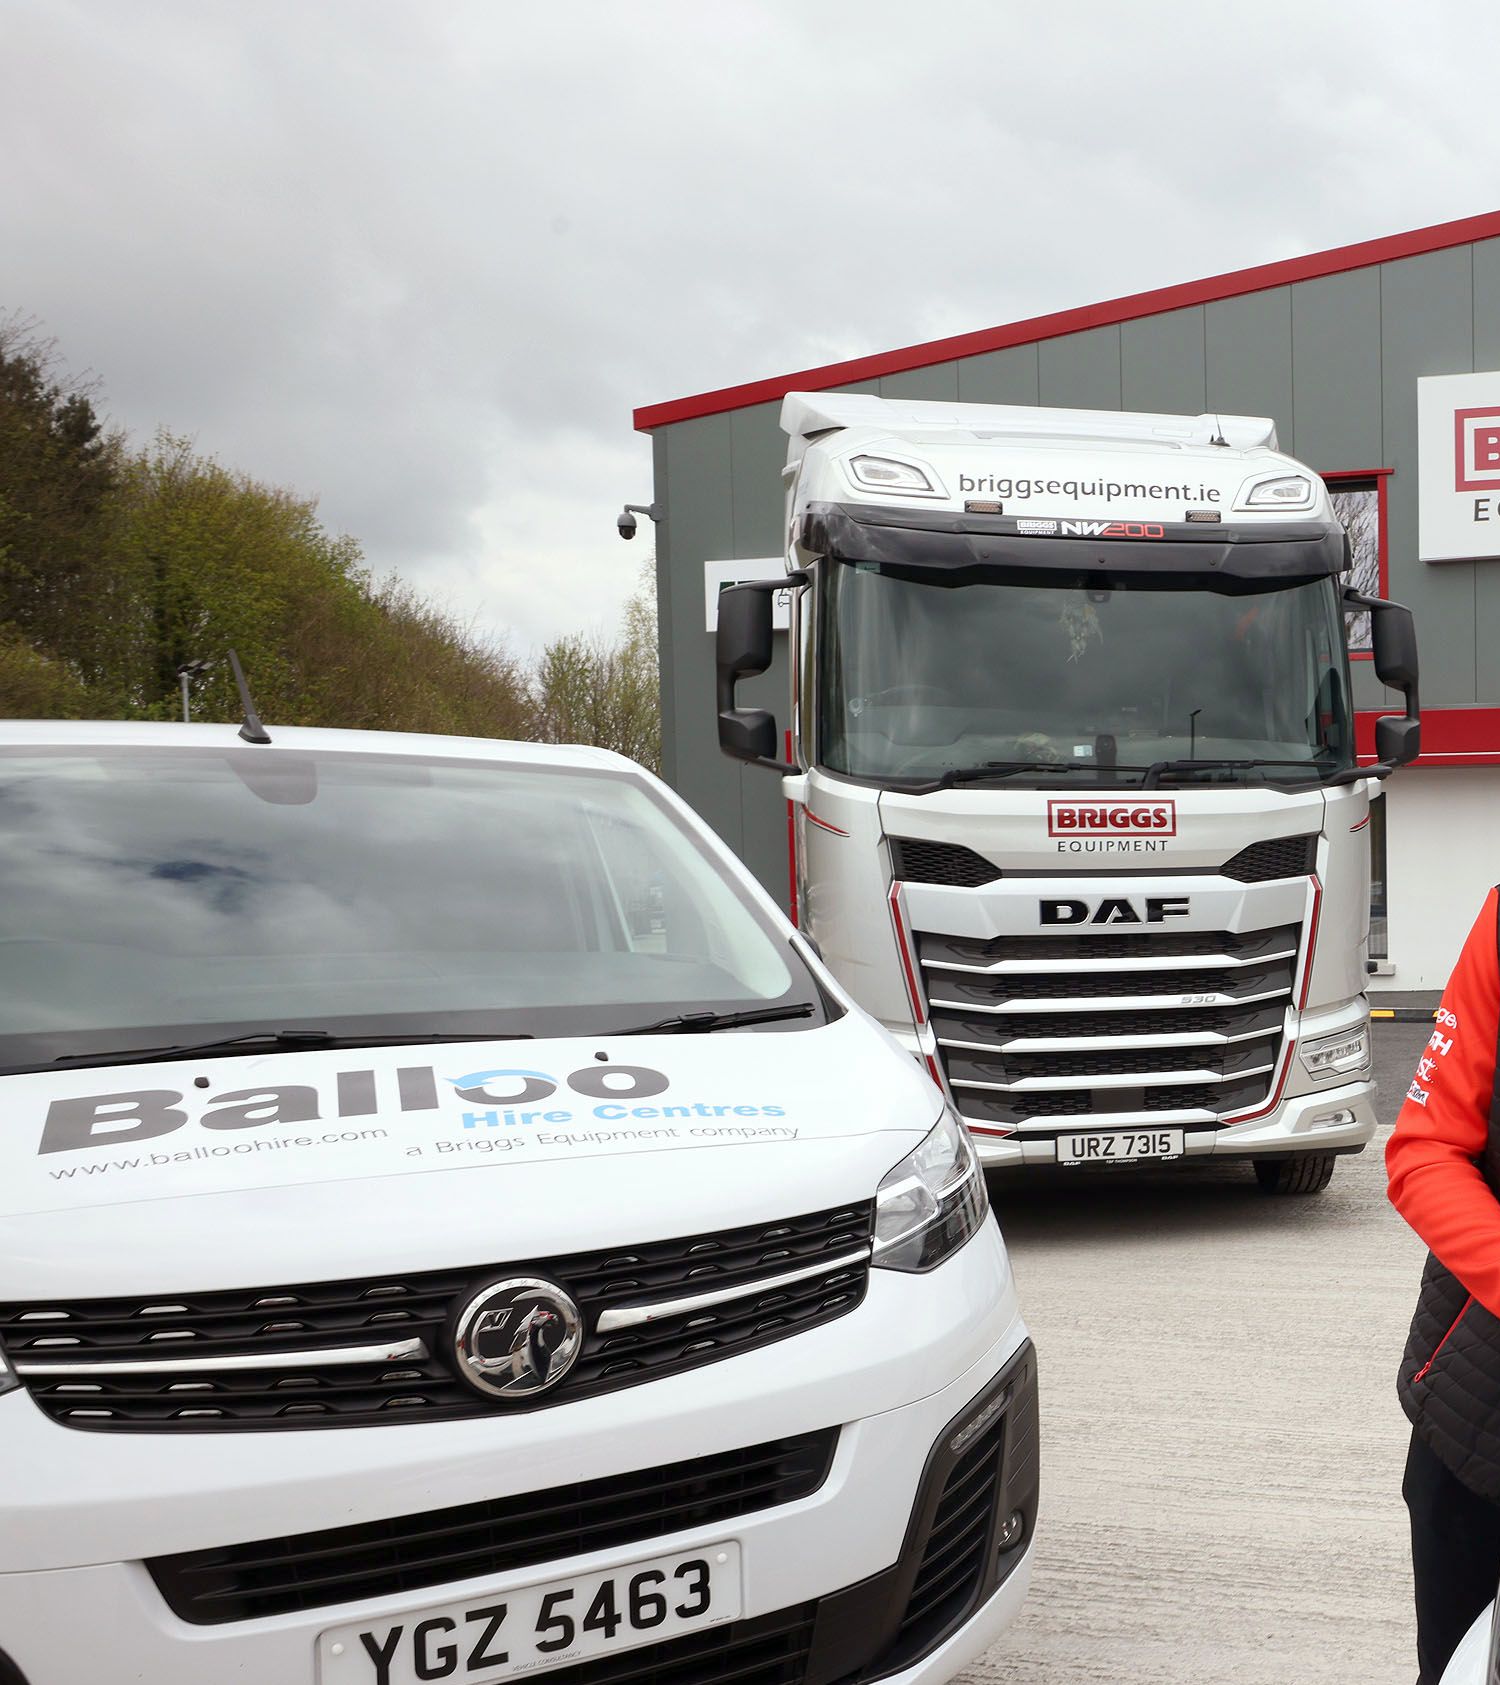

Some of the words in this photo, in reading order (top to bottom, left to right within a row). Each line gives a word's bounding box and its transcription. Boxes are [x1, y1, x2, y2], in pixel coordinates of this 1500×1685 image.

[959, 474, 1221, 502] briggsequipment.ie
[1056, 808, 1168, 828] BRIGGS
[1057, 840, 1168, 852] EQUIPMENT
[1039, 896, 1190, 926] DAF
[38, 1065, 671, 1155] Balloo
[461, 1108, 573, 1129] Hire
[592, 1102, 786, 1120] Centres
[49, 1126, 389, 1180] www.balloohire.com
[405, 1146, 423, 1157] a
[436, 1134, 526, 1154] Briggs
[537, 1126, 680, 1146] Equipment
[690, 1124, 799, 1140] company
[1072, 1137, 1115, 1158] URZ
[1122, 1134, 1171, 1156] 7315
[359, 1603, 510, 1685] YGZ
[535, 1559, 711, 1654] 5463
